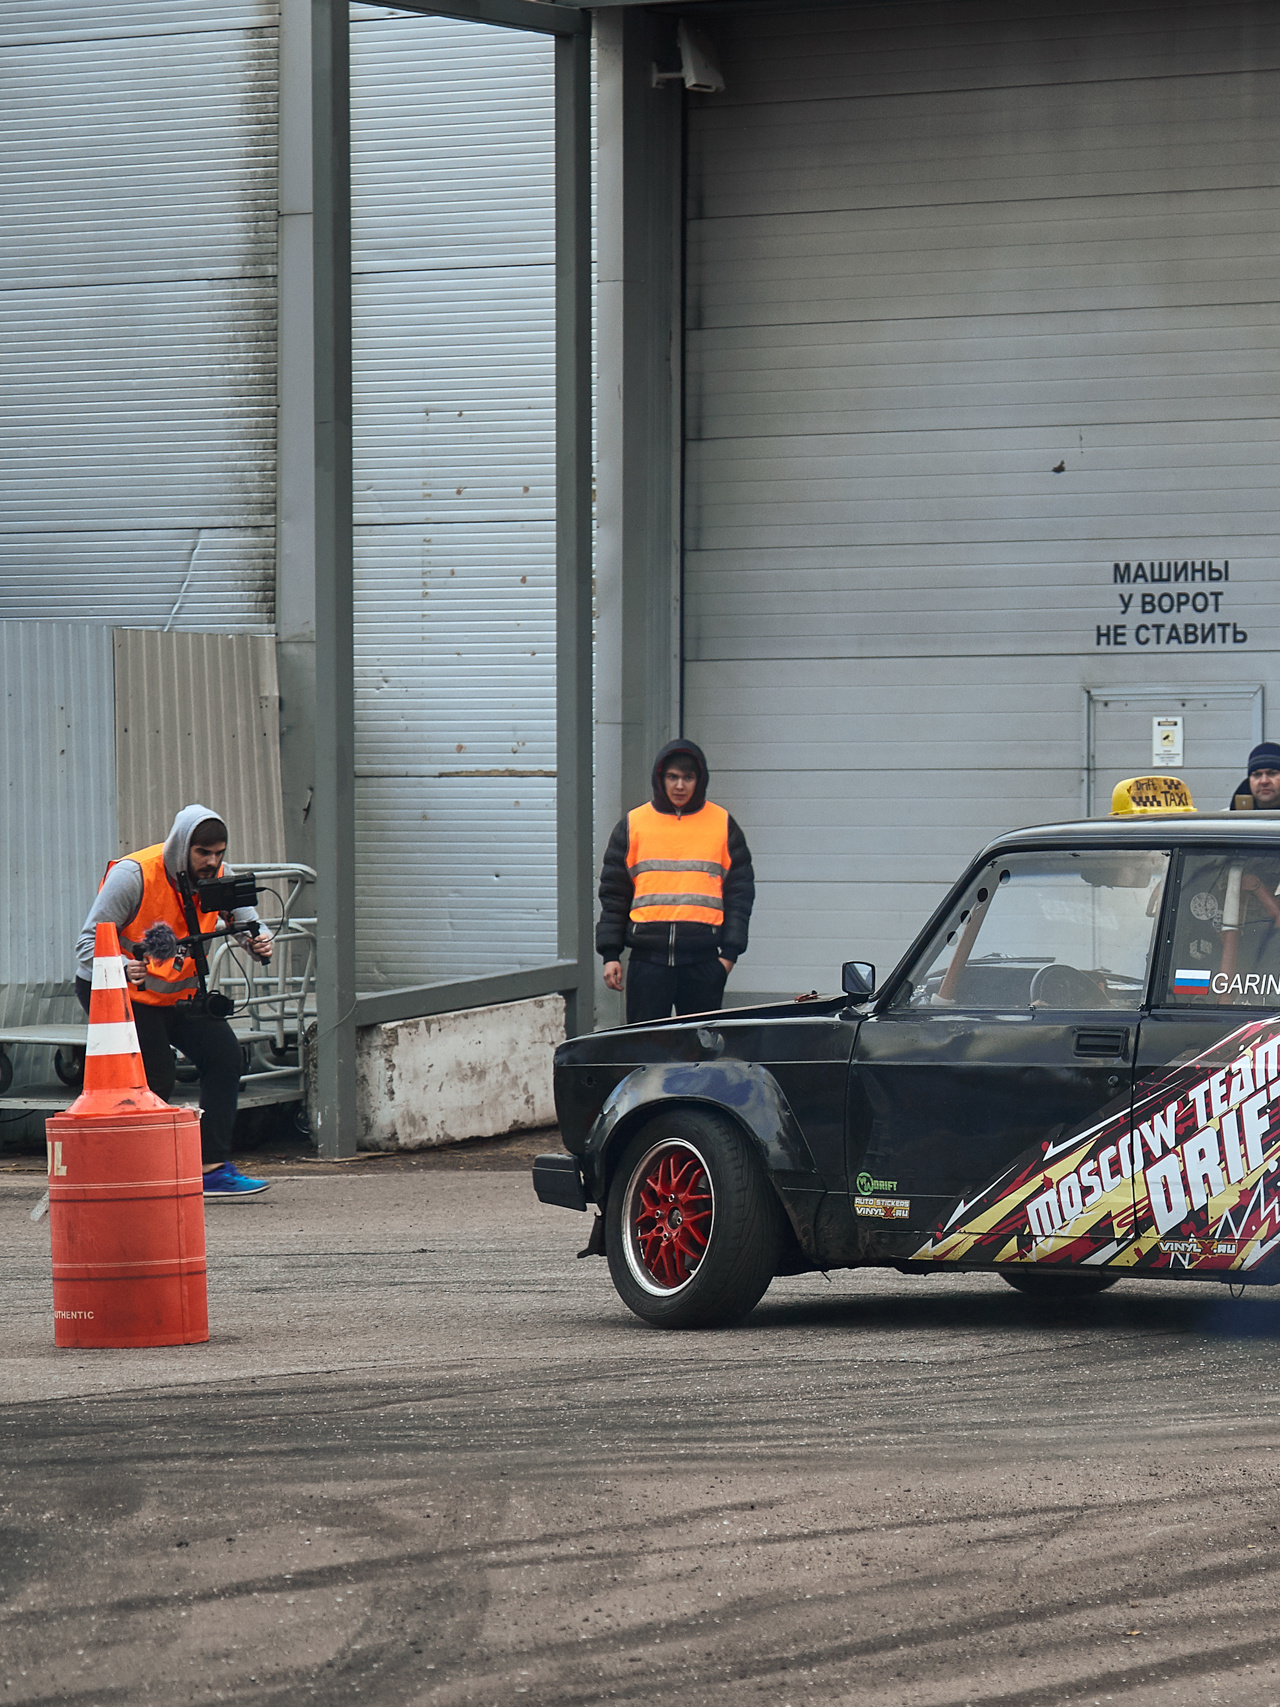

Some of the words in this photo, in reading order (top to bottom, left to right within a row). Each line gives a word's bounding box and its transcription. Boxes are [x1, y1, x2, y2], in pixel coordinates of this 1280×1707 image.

[1113, 560, 1230, 584] МАШИНЫ
[1118, 593, 1134, 614] У
[1141, 591, 1224, 614] ВОРОТ
[1096, 624, 1127, 646] НЕ
[1135, 622, 1248, 646] СТАВИТЬ
[1136, 779, 1158, 791] Drift
[1160, 790, 1189, 807] TAXI
[1026, 1101, 1179, 1243] MOSCOW
[873, 1180, 898, 1191] DRIFT
[876, 1199, 910, 1207] STICKERS
[54, 1311, 95, 1319] UTHENTIC
